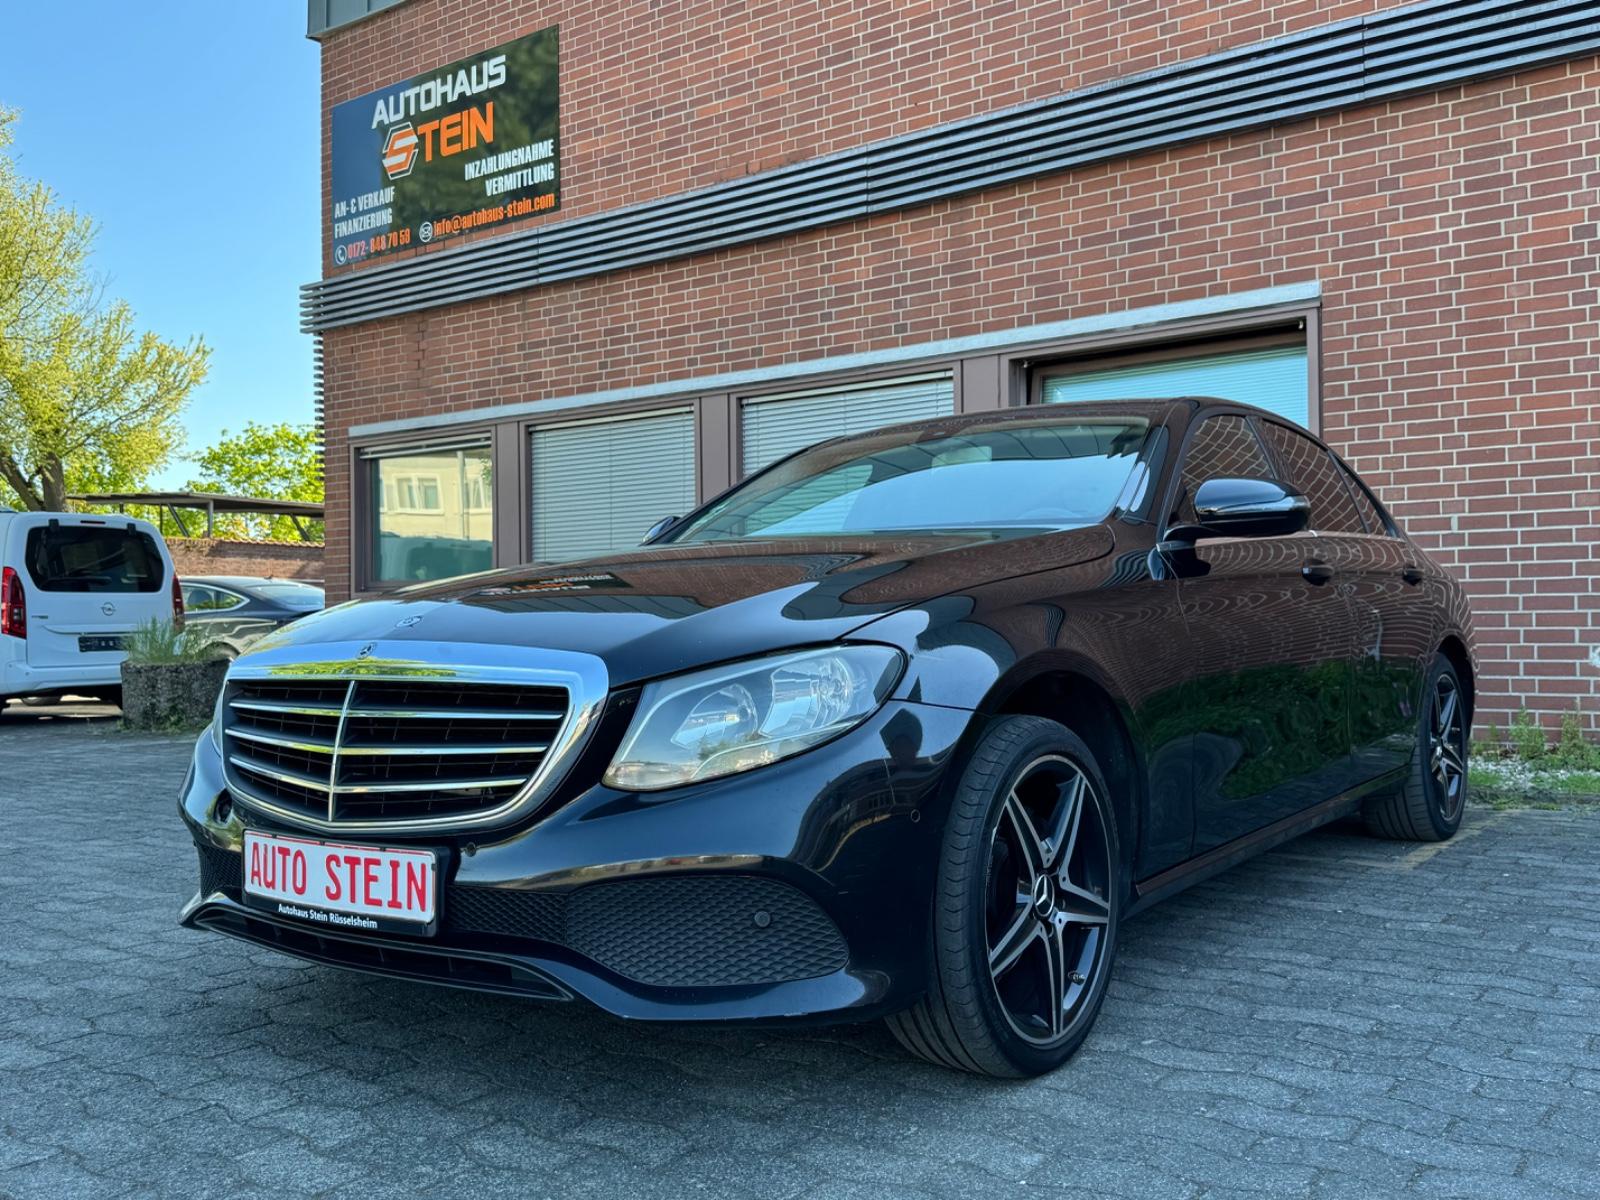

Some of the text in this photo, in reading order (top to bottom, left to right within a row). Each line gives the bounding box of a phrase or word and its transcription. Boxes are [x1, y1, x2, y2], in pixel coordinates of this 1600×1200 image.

[371, 54, 506, 129] AUTOHAUS
[382, 101, 494, 179] STEIN
[464, 139, 554, 181] INZAHLUNGNAHME
[485, 162, 555, 197] VERMITTLUNG
[334, 208, 393, 239] FINANZIERUNG
[335, 186, 395, 219] AN- & VERKAUF
[433, 193, 555, 237] info@autohaus-stein.com
[250, 841, 427, 912] AUTO STEIN
[278, 903, 378, 929] Autohaus Stein Rüsselsheim
